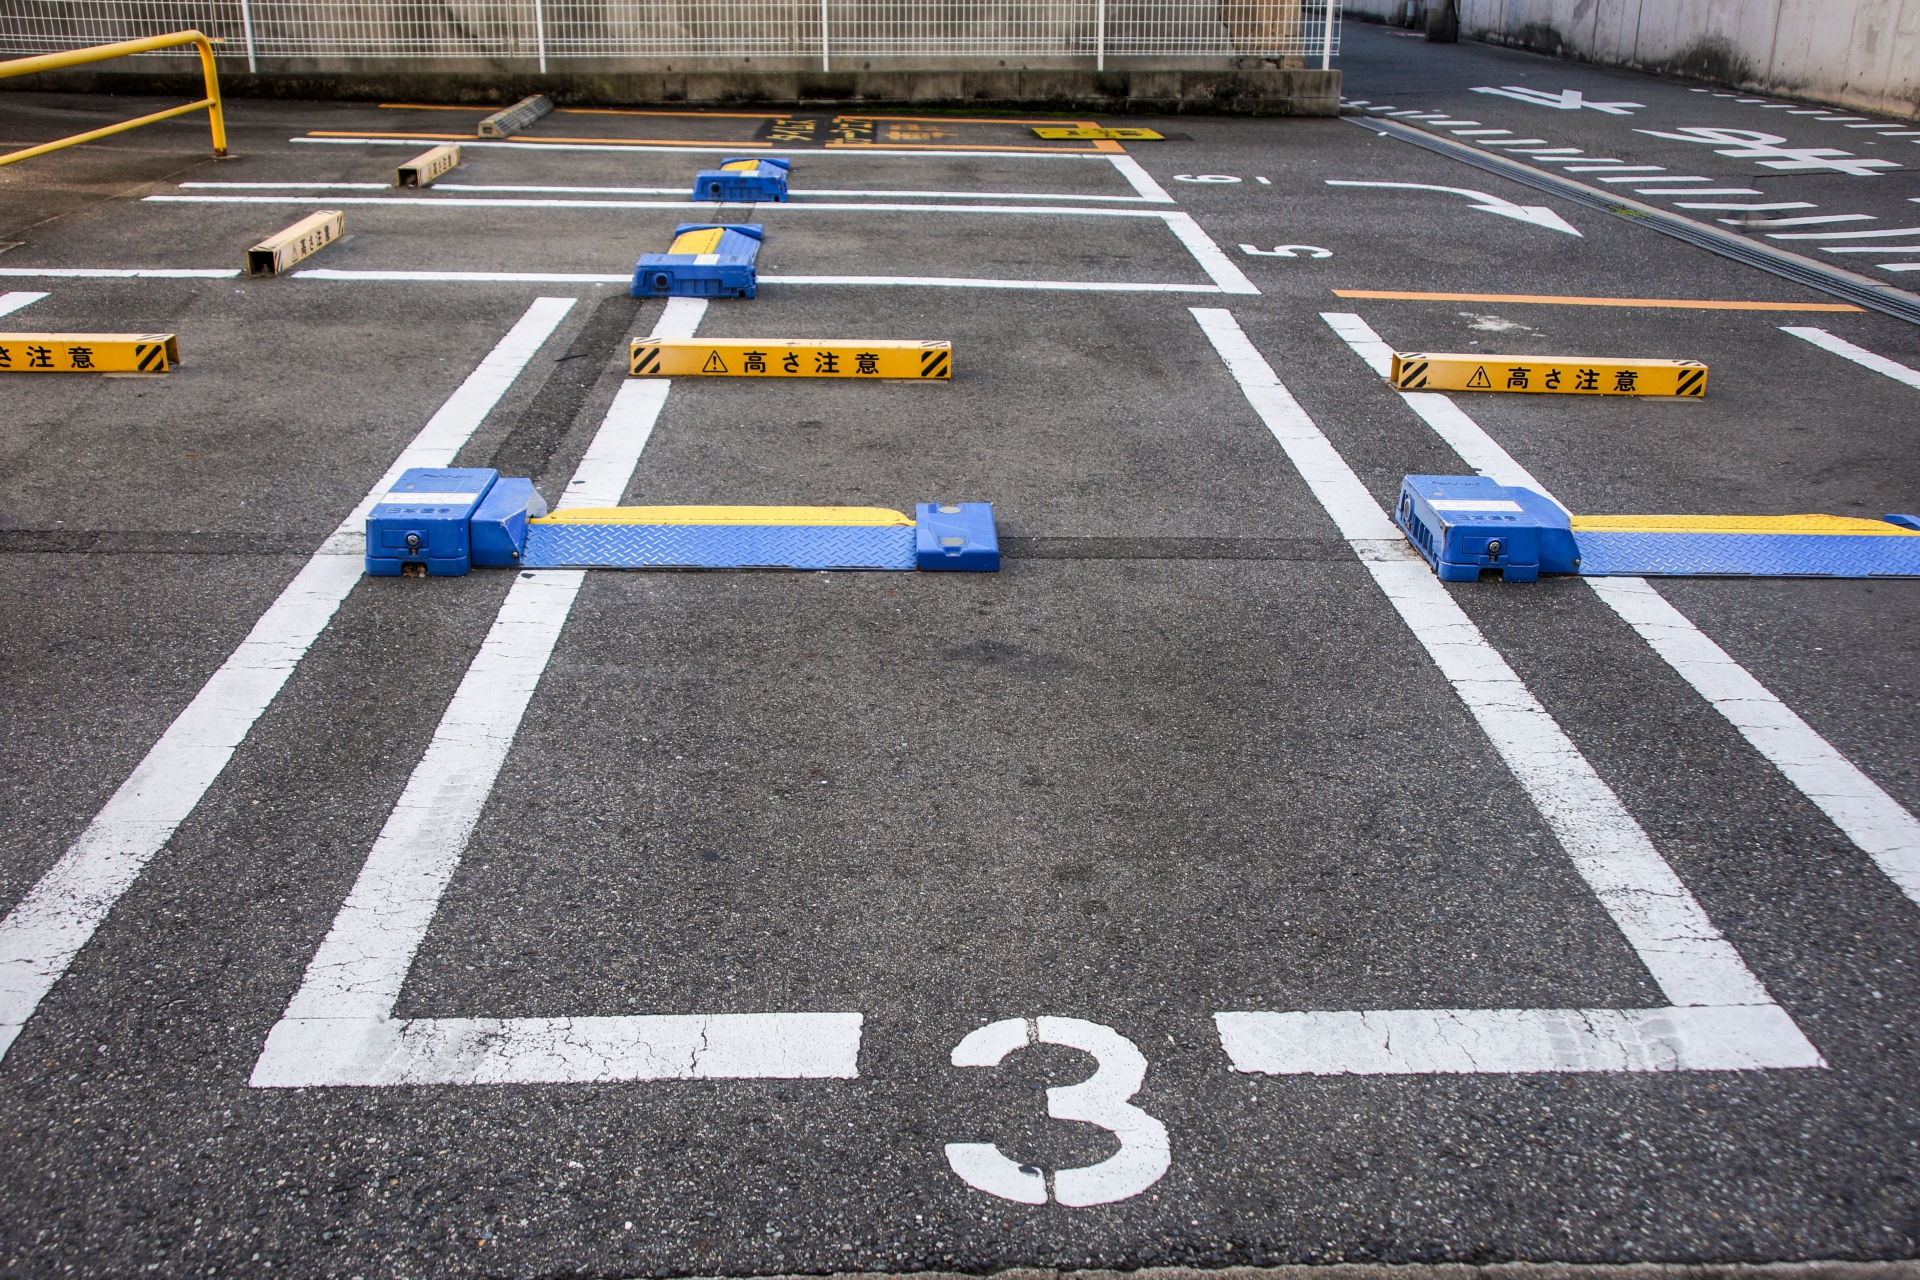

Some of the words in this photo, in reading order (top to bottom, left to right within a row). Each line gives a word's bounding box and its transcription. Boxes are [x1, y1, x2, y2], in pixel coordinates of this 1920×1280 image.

[300, 225, 331, 256] 高さ注意
[1238, 243, 1333, 258] 5
[743, 350, 879, 374] 高さ注意
[1507, 367, 1639, 392] 高さ注意
[944, 1015, 1172, 1208] 3
